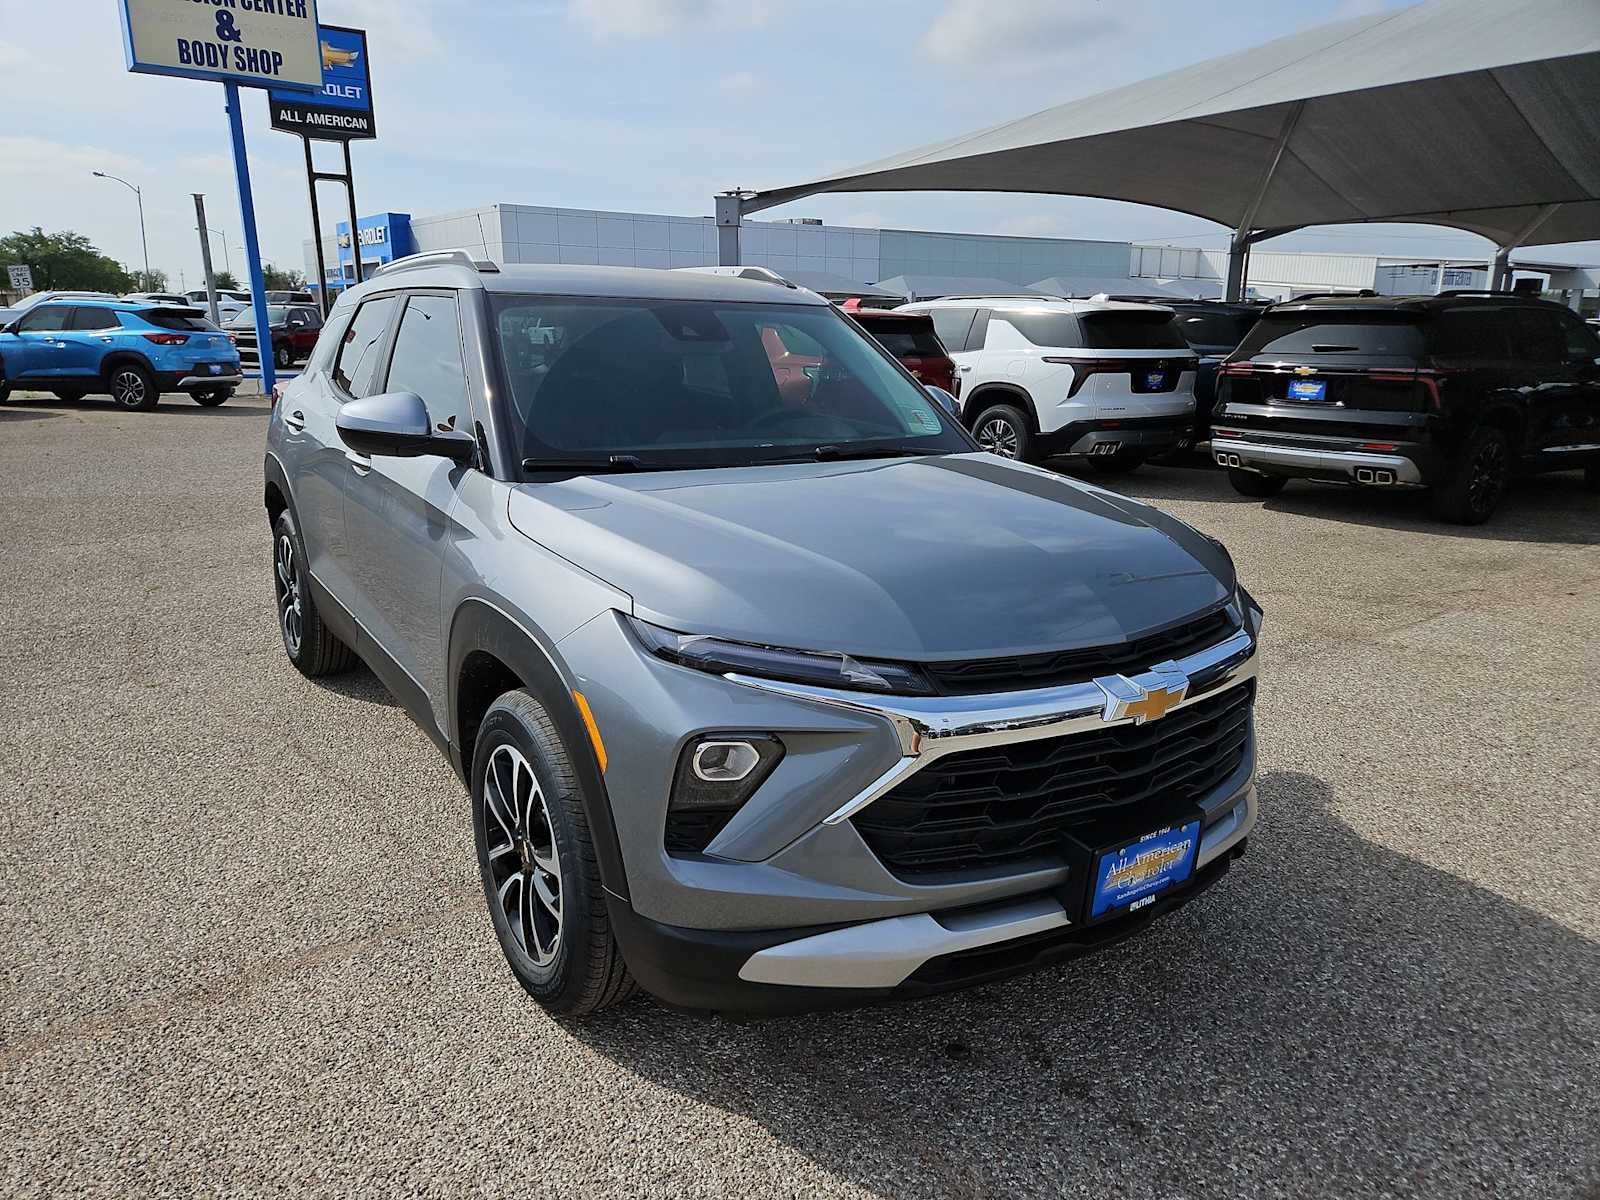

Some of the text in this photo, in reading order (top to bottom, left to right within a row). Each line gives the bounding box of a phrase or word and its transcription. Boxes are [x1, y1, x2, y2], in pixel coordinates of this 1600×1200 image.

[215, 9, 243, 42] &
[177, 38, 283, 75] BODY SHOP
[280, 109, 368, 129] ALL AMERICAN
[12, 278, 30, 287] 35
[1105, 839, 1192, 880] All American
